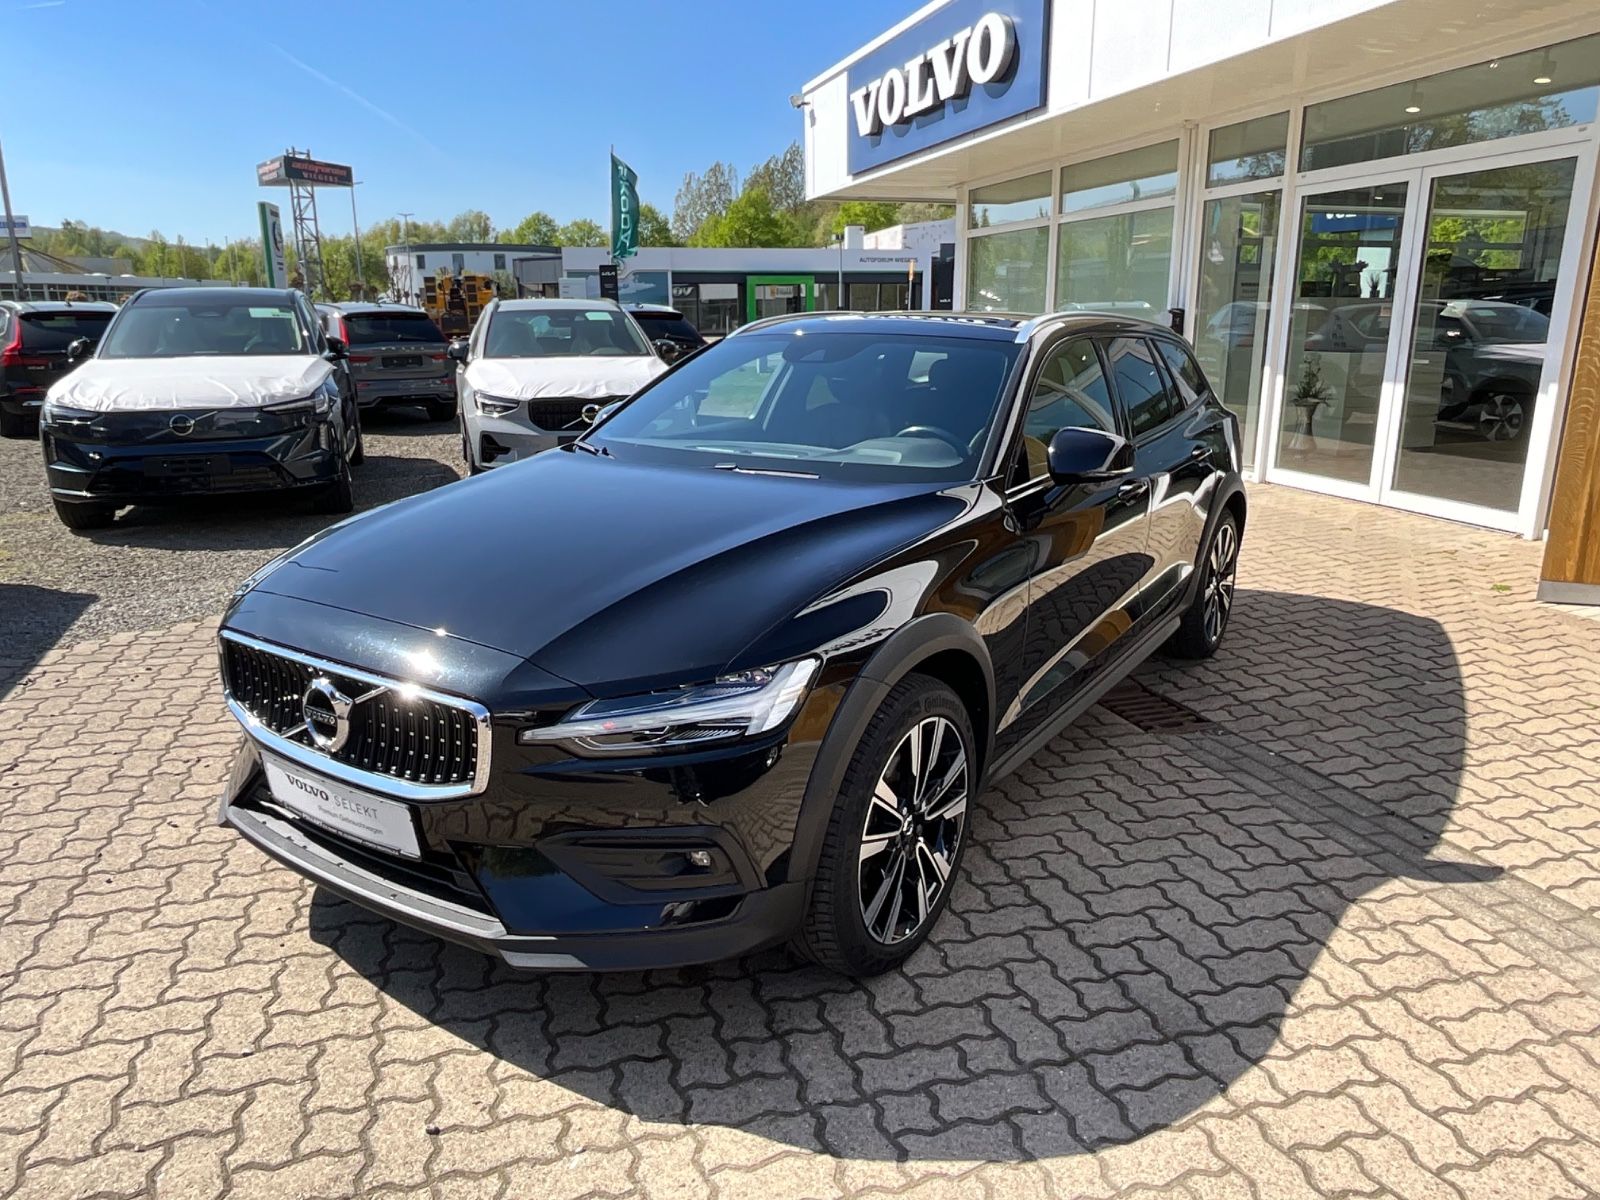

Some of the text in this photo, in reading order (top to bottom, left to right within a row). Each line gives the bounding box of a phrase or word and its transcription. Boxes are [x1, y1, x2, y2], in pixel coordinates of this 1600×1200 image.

[850, 12, 1013, 136] VOLVO
[305, 708, 336, 725] VOLVO
[285, 773, 378, 819] VOLVO SELEKT
